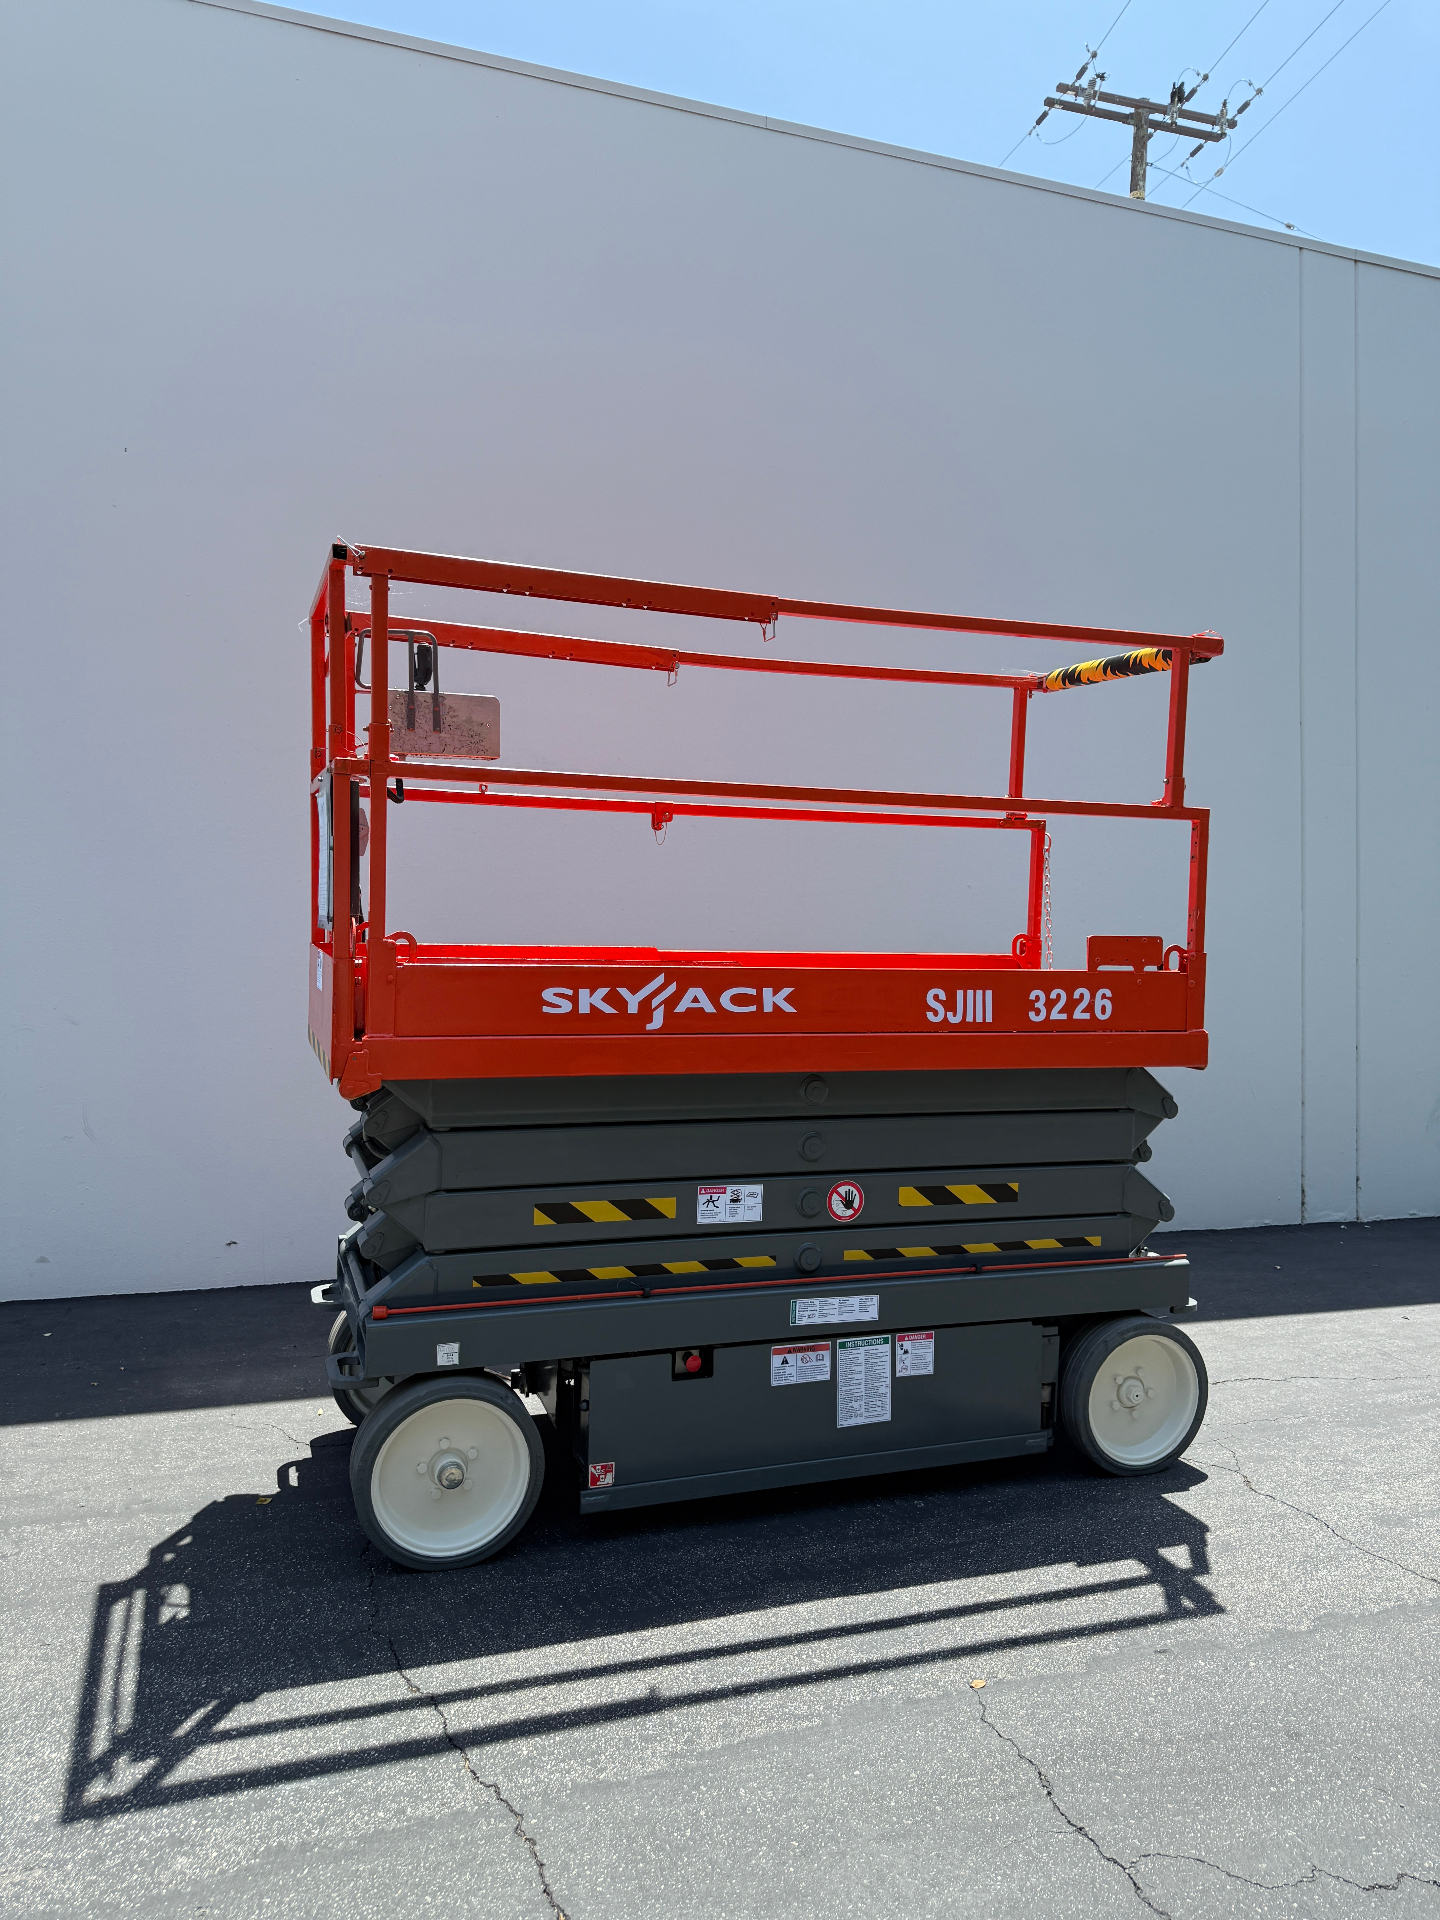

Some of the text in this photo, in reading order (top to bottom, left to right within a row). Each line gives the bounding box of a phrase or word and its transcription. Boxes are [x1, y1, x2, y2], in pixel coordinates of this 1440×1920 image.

[541, 972, 798, 1031] SKYJACK
[925, 987, 1113, 1024] SJIII 3226
[845, 1338, 884, 1348] INSTRUCTIONS
[908, 1333, 927, 1341] DANGER
